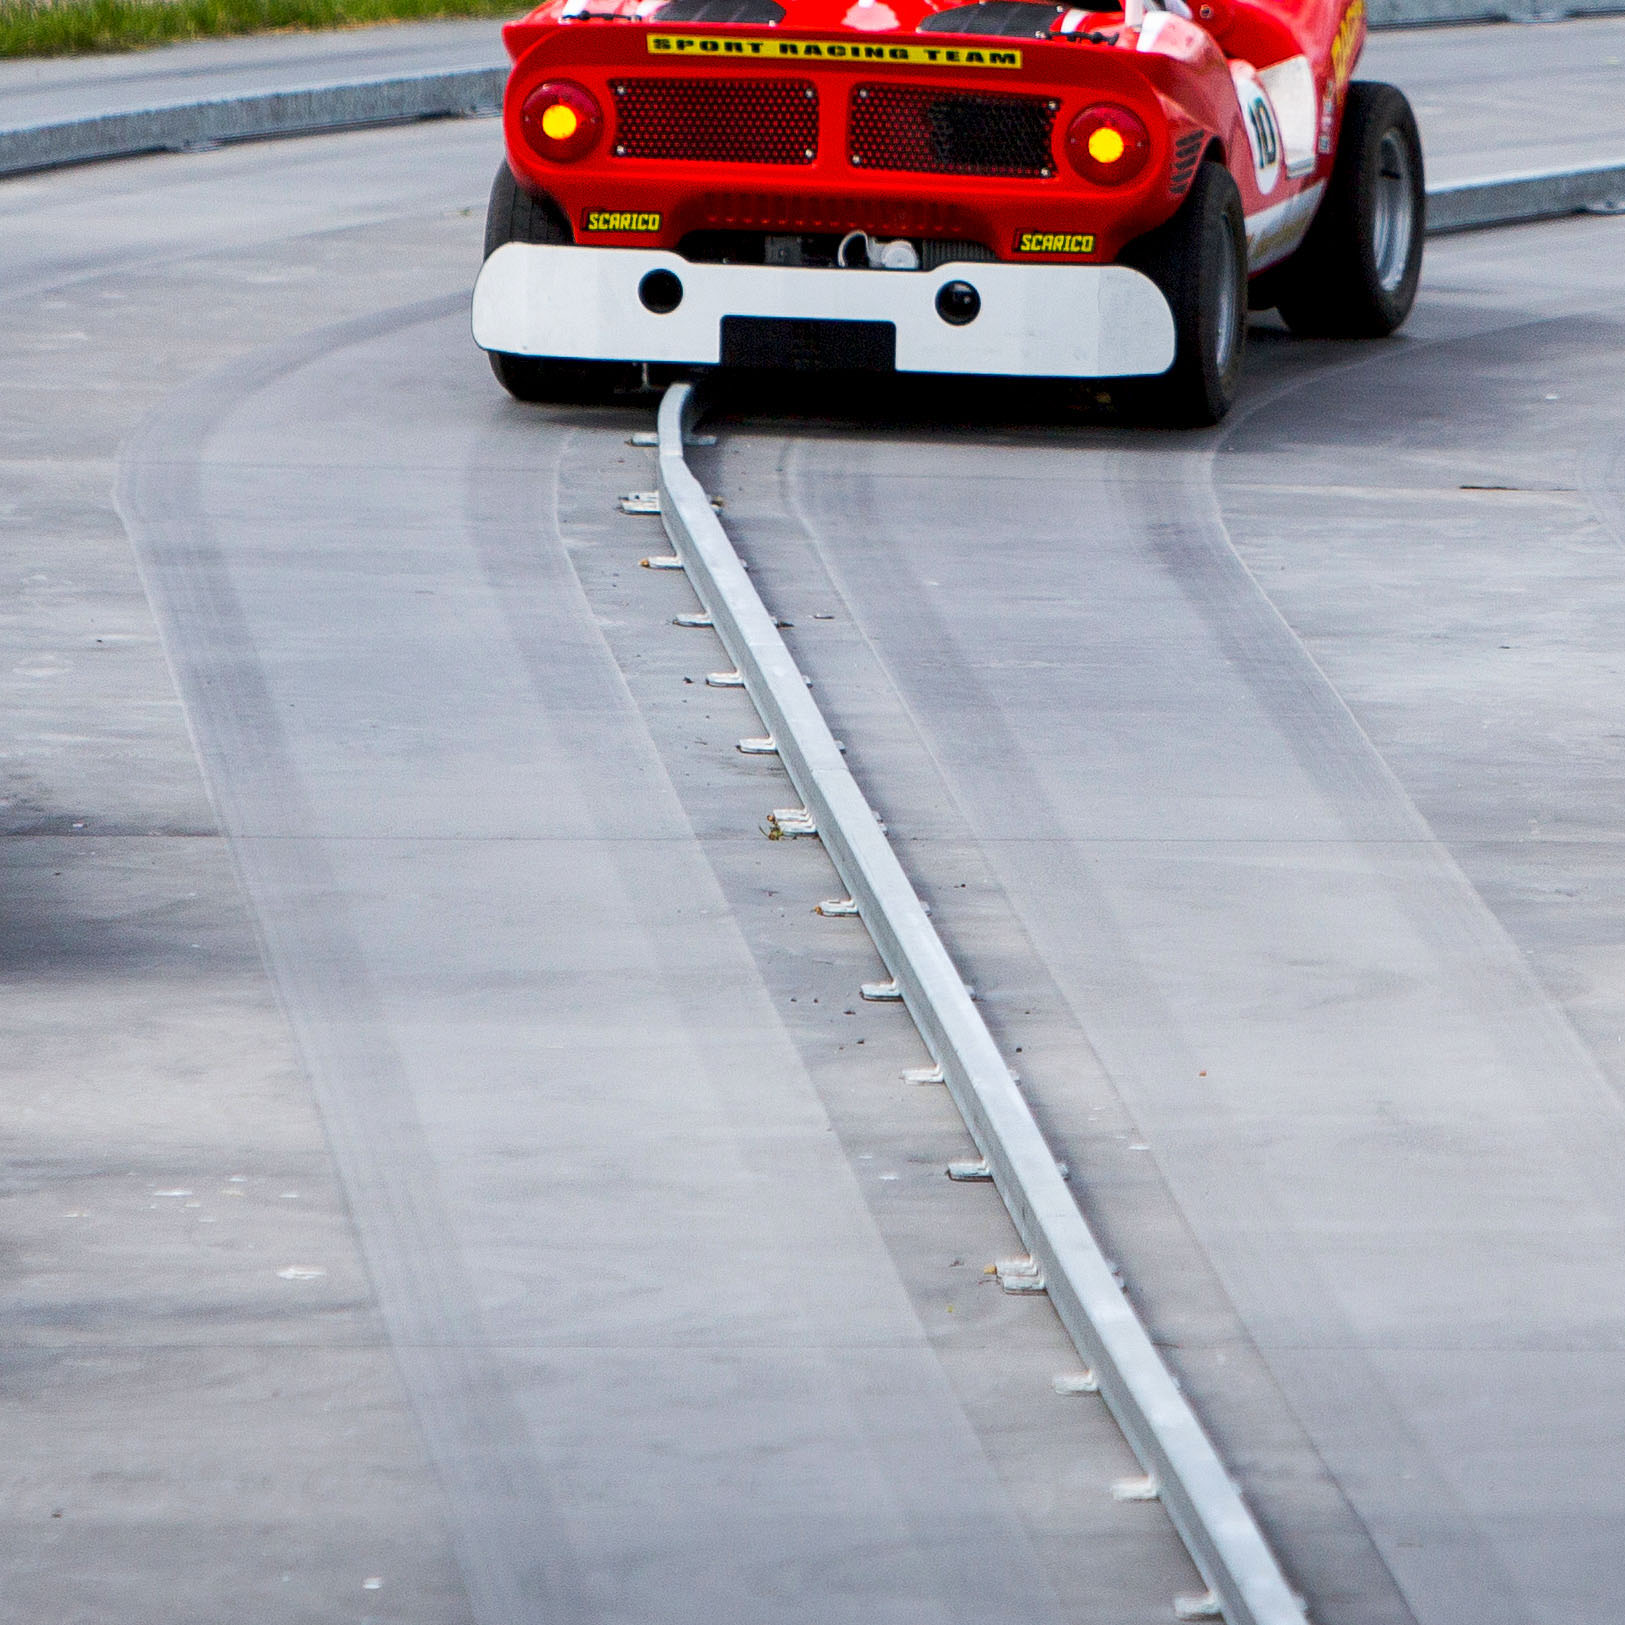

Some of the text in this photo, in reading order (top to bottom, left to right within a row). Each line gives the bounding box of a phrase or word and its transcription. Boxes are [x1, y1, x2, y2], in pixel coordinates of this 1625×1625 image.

[652, 37, 1017, 65] SPORT RACING TEAM
[1248, 96, 1276, 169] 10
[589, 212, 660, 231] SCARICO
[1020, 233, 1094, 253] SCARICO
